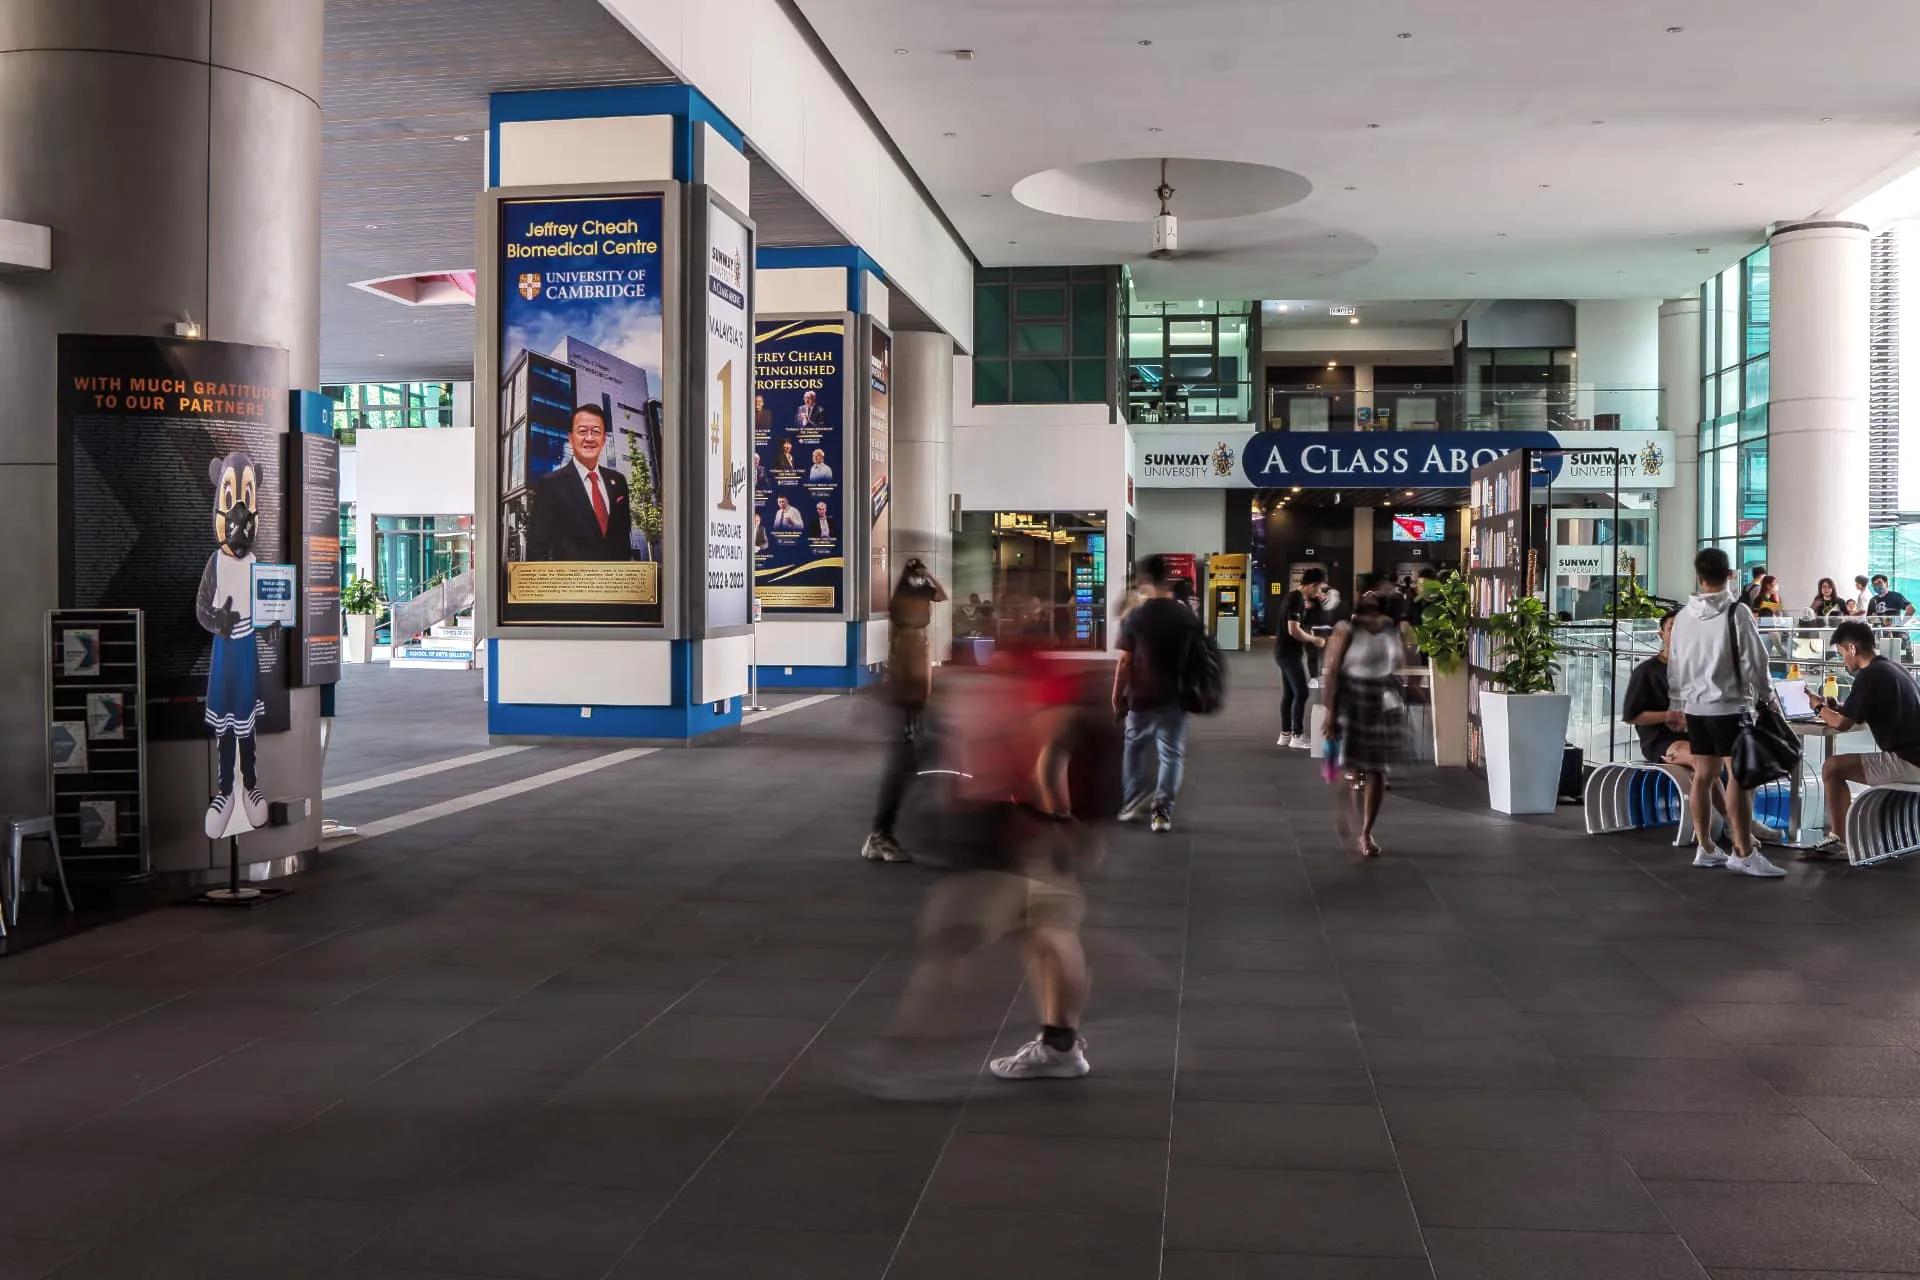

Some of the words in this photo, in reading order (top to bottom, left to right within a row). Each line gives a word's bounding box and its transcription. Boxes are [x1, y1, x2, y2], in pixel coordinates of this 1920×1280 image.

[525, 222, 577, 239] Jeffrey
[582, 219, 638, 236] Cheah
[507, 241, 598, 258] Biomedical
[602, 239, 657, 255] Centre
[712, 246, 733, 271] SUNWAY
[546, 270, 624, 283] UNIVERSITY
[628, 269, 646, 281] OF
[546, 284, 646, 299] CAMBRIDGE
[709, 314, 744, 349] MALAYSIA'S
[788, 350, 832, 362] CHEAH
[74, 377, 121, 392] WITH
[130, 377, 185, 394] MUCH
[193, 381, 281, 400] GRATITUDE
[754, 379, 823, 390] ROFESSORS
[95, 394, 117, 409] TO
[126, 396, 165, 410] OUR
[179, 398, 264, 417] PARTNERS
[1144, 454, 1210, 466] SUNWAY
[1260, 445, 1290, 474] A
[1300, 444, 1409, 474] CLASS
[1570, 453, 1638, 465] SUNWAY
[1144, 467, 1209, 477] UNIVERSITY
[717, 522, 742, 539] GRADUATE
[708, 544, 743, 560] EMPLOYABILITY
[708, 571, 723, 589] 2022
[729, 571, 744, 589] 2023
